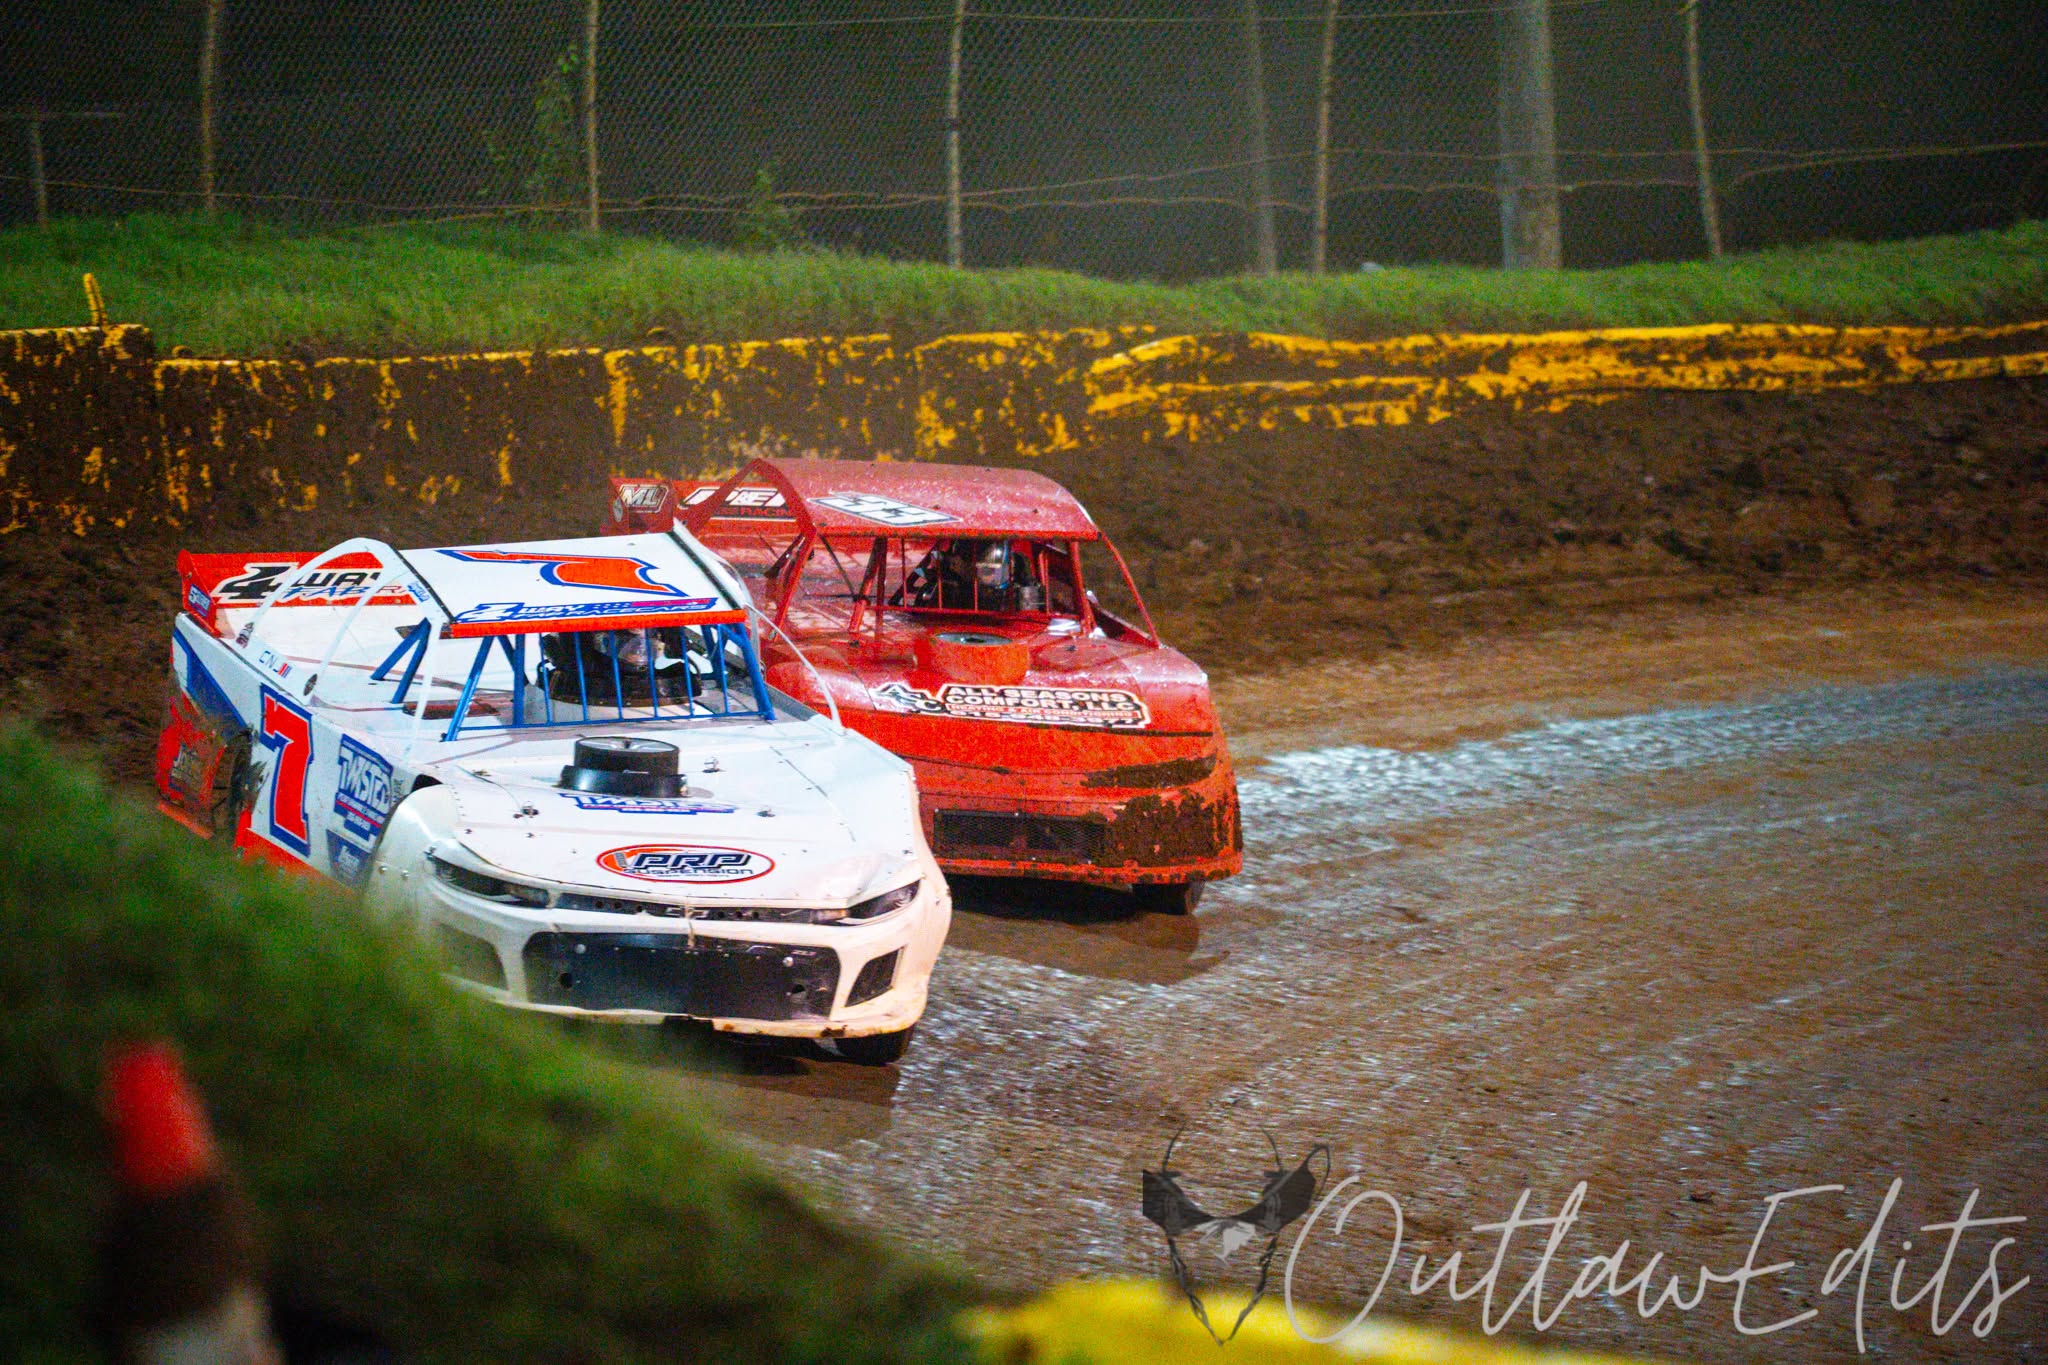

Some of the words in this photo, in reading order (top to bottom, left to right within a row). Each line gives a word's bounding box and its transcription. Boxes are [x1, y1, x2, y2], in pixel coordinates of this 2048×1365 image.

[292, 572, 381, 588] WA
[946, 695, 1080, 711] COMFORT,
[1087, 701, 1136, 711] LLC
[948, 687, 998, 697] ALL
[1004, 688, 1127, 703] SEASONS
[260, 684, 313, 855] 7
[633, 853, 751, 869] PRP
